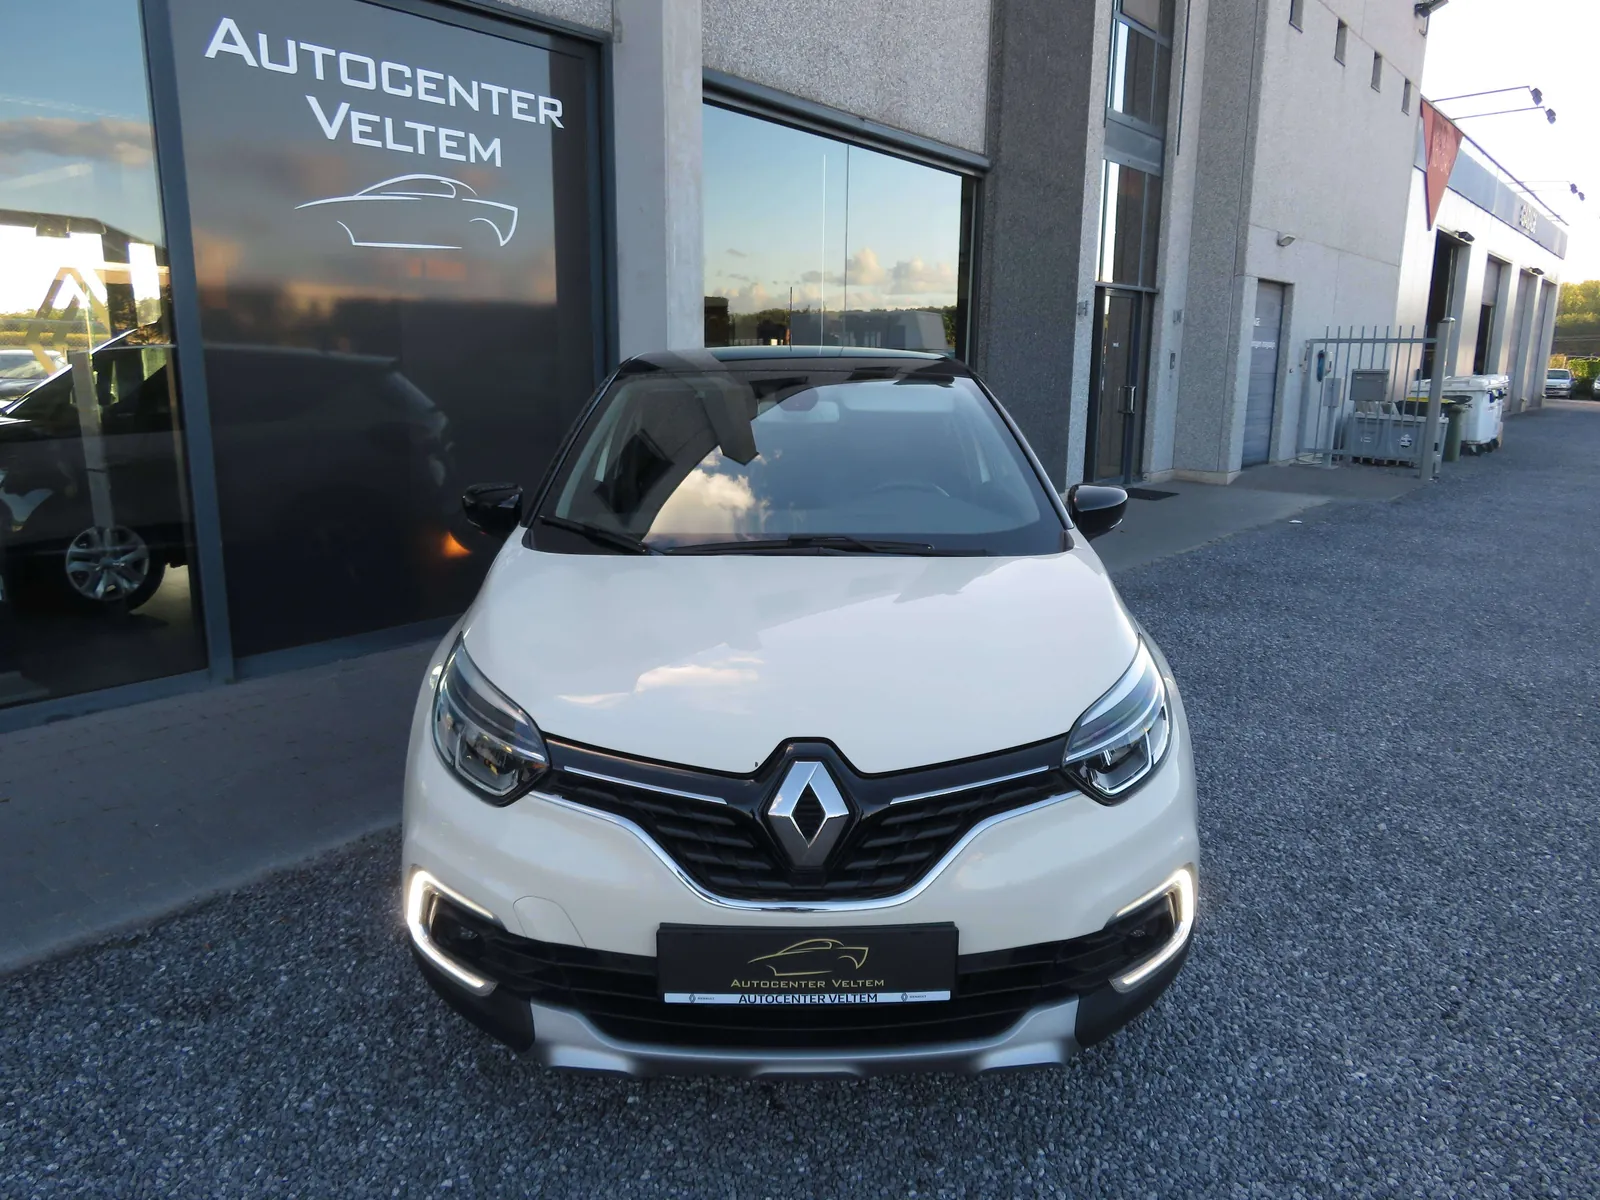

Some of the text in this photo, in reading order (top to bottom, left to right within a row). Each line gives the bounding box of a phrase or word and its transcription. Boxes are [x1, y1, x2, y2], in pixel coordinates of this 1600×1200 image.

[205, 17, 564, 129] AUTOCENTER
[305, 95, 502, 168] VELTEM
[731, 978, 885, 988] AUTOCENTER VELTEM
[739, 993, 877, 1003] AUTOCENTER VELTEM
